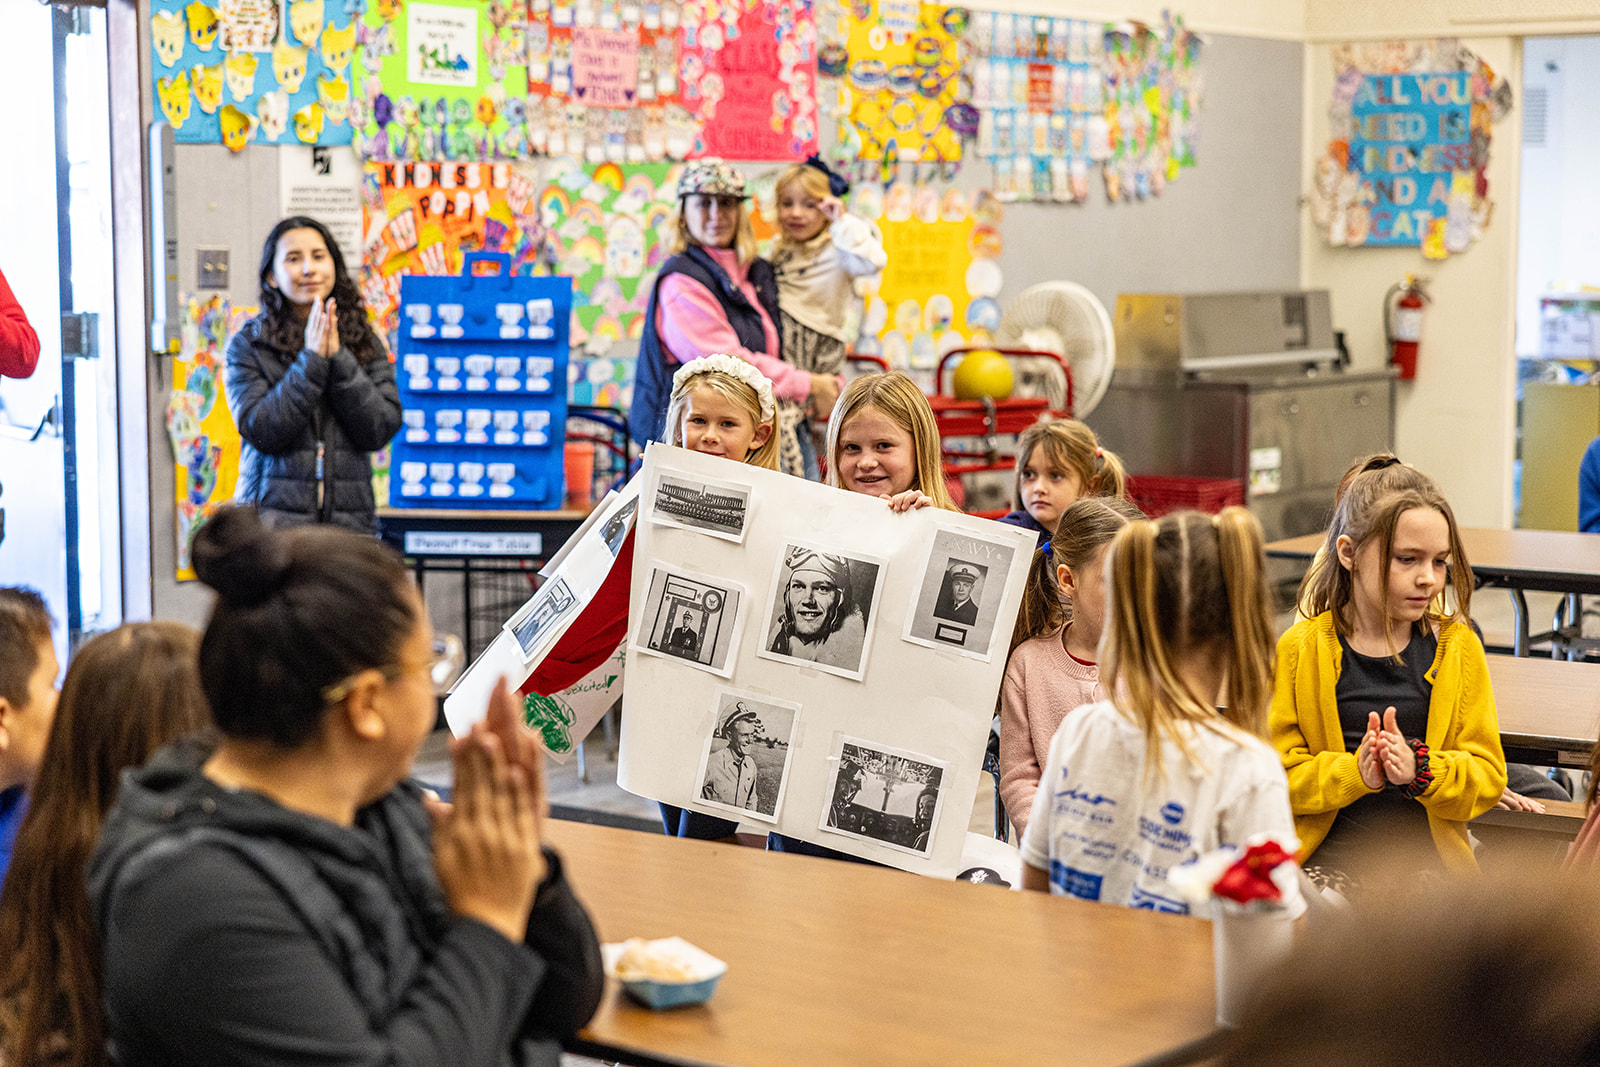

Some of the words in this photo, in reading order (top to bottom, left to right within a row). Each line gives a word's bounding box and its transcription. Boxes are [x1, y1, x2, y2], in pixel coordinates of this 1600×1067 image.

[1356, 75, 1410, 106] ALL
[1415, 76, 1471, 105] YOU
[1350, 113, 1427, 142] NEED
[1438, 111, 1465, 140] IS
[384, 163, 480, 189] KINDNESS
[490, 163, 508, 189] IS
[1427, 178, 1449, 205] A
[951, 538, 997, 559] NAVY
[572, 674, 618, 694] excited!
